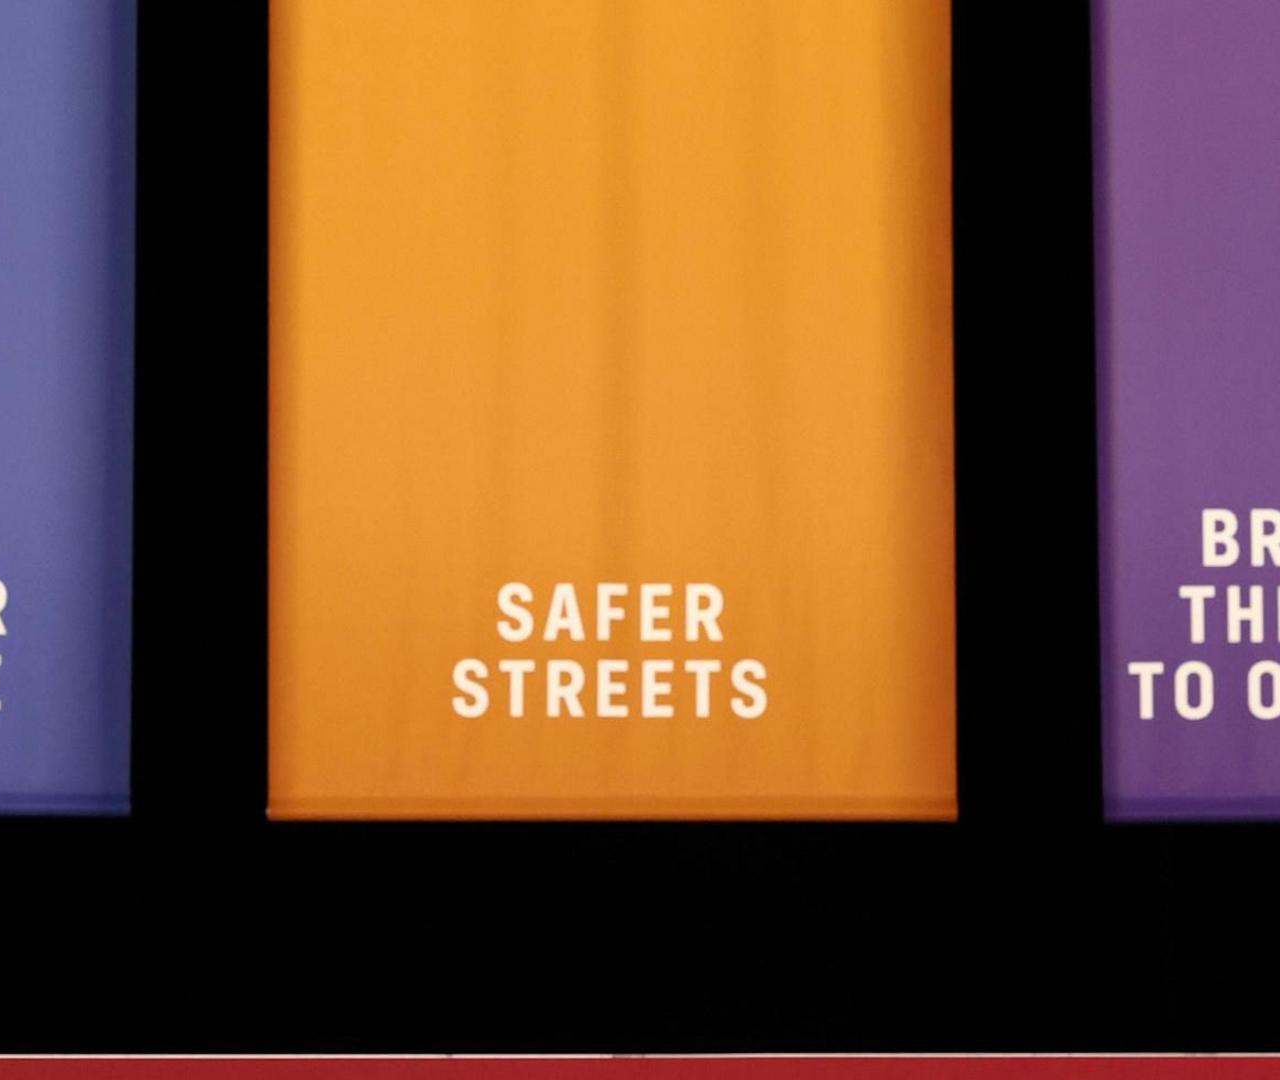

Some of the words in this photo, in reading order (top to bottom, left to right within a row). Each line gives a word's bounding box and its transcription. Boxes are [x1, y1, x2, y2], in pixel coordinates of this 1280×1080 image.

[497, 582, 724, 642] SAFER
[452, 658, 768, 719] STREETS
[1127, 660, 1214, 721] TO
